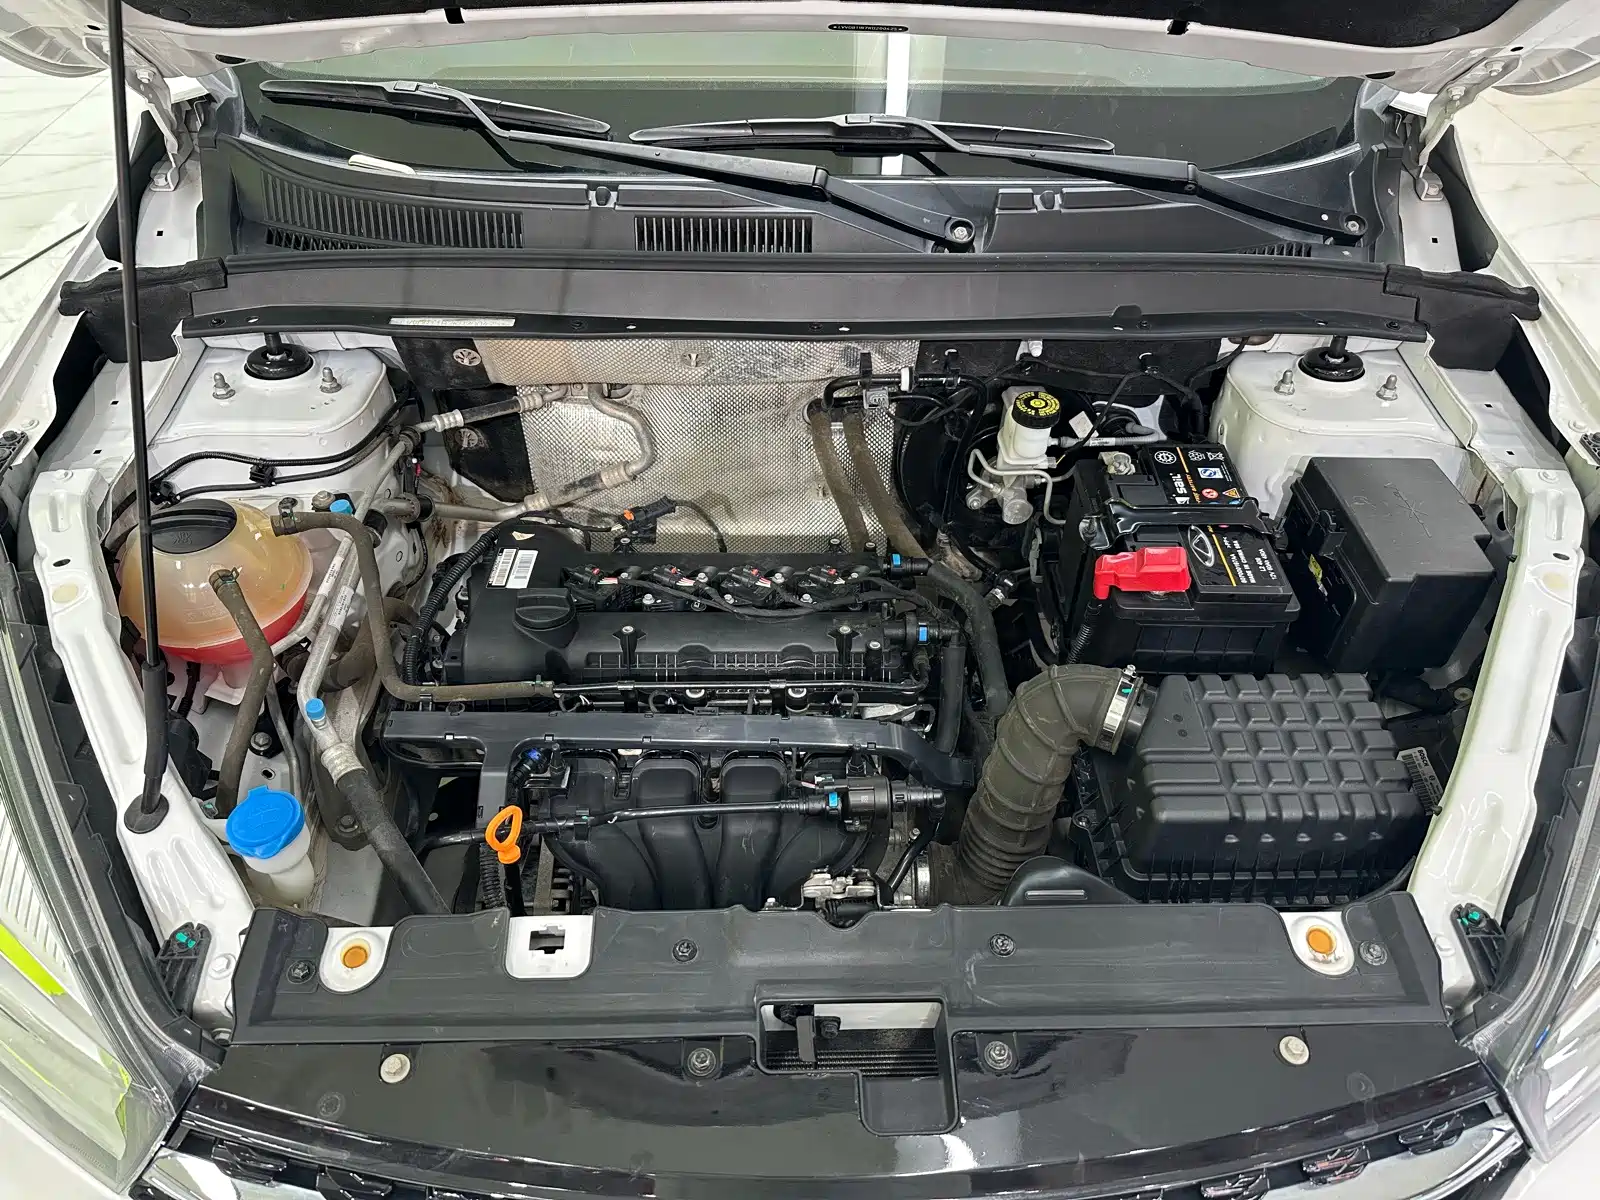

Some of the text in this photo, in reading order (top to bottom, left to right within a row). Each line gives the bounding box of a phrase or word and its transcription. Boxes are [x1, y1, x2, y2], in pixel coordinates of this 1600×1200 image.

[1236, 549, 1247, 564] CHINA
[1245, 570, 1256, 583] MADE
[1268, 571, 1277, 580] 12V
[1417, 749, 1430, 767] BOSCH
